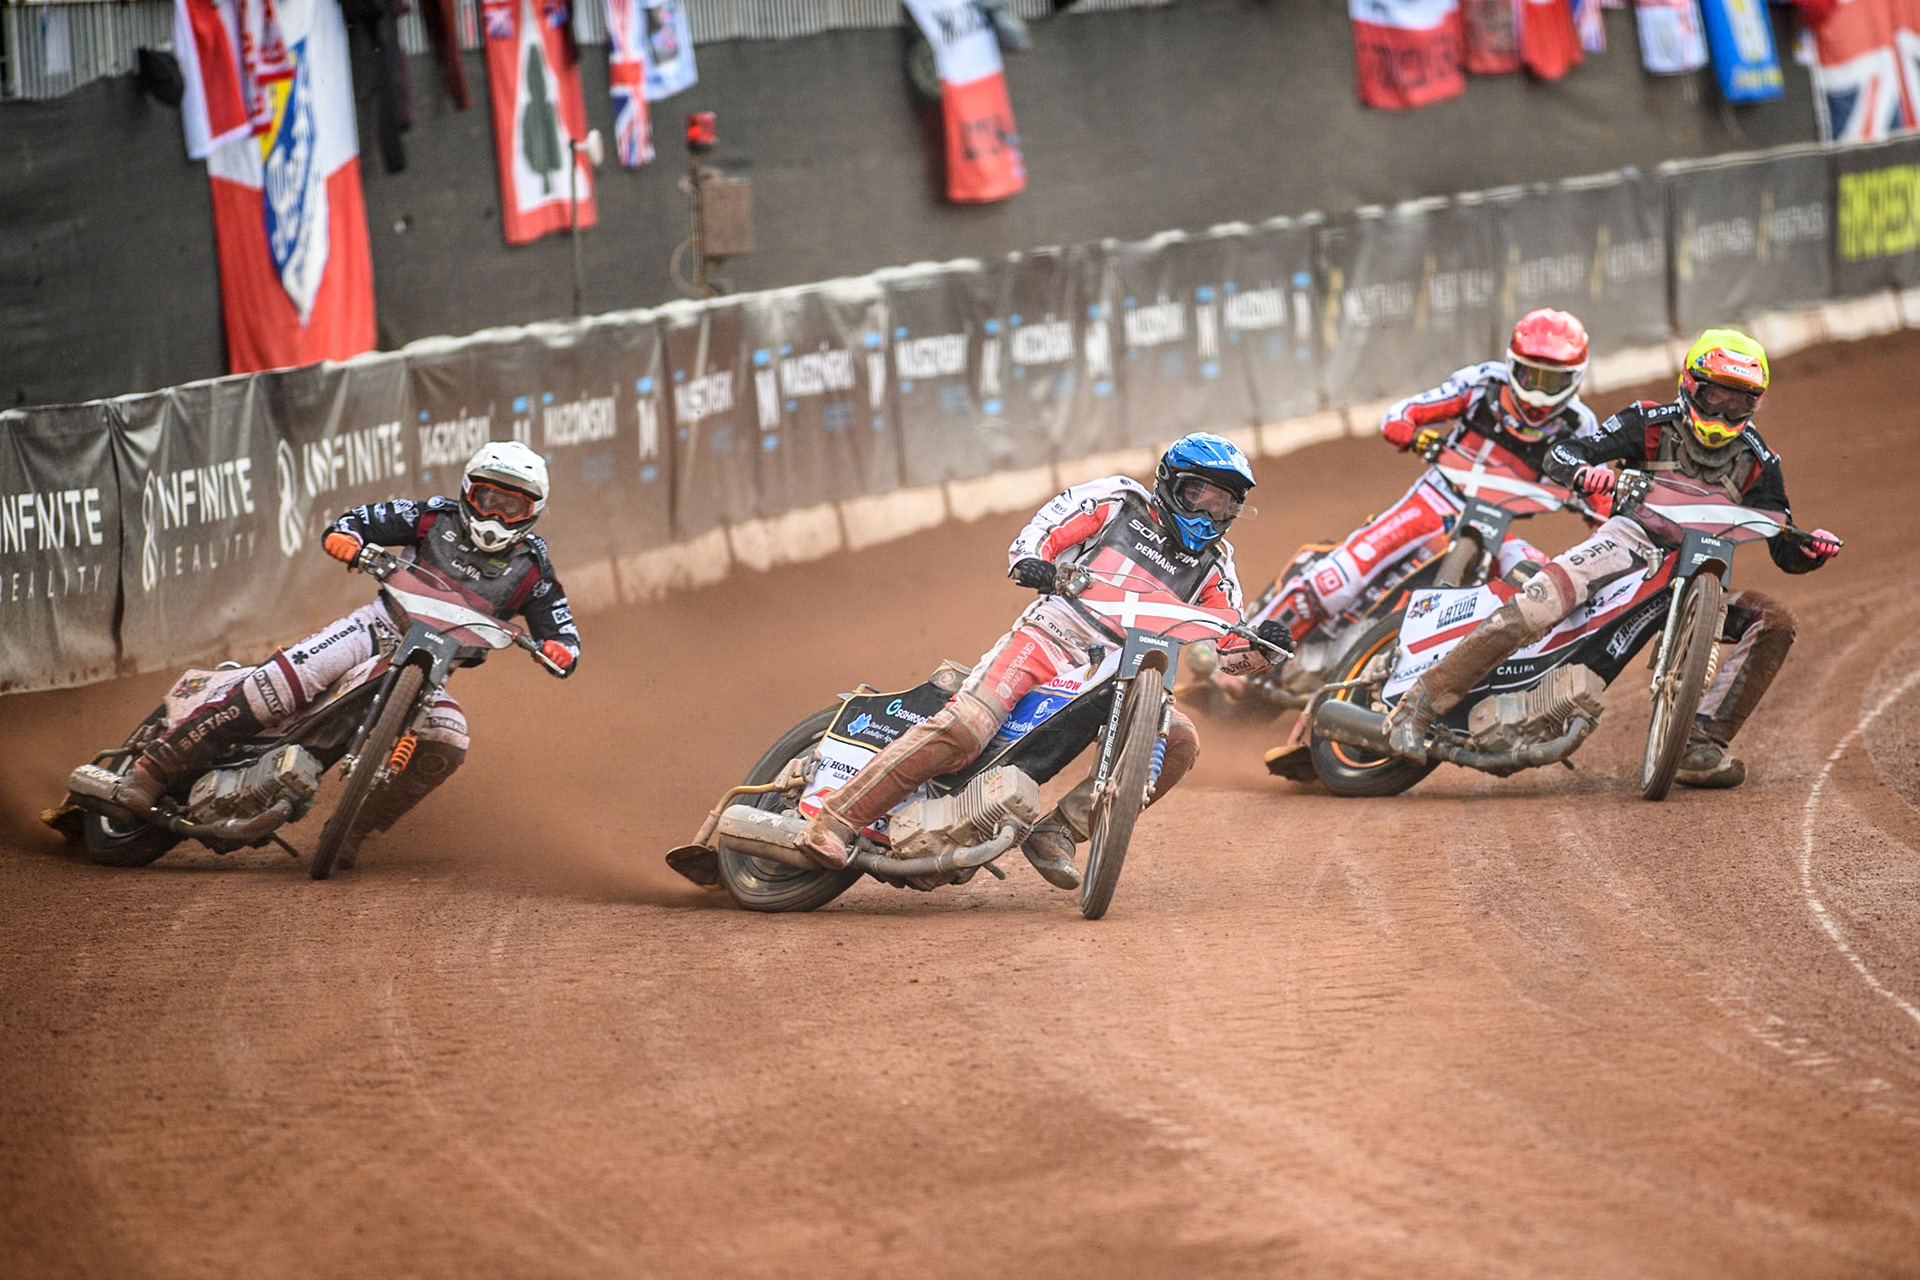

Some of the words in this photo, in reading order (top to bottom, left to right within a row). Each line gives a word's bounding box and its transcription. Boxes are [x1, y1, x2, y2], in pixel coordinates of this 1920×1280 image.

[1647, 405, 1680, 419] SOFI
[0, 488, 103, 554] NFINITE
[1128, 519, 1167, 545] SON
[1134, 542, 1178, 576] DENMARK
[424, 631, 445, 645] LATVIA
[1138, 635, 1169, 648] DENMARK
[187, 704, 241, 744] BETARD
